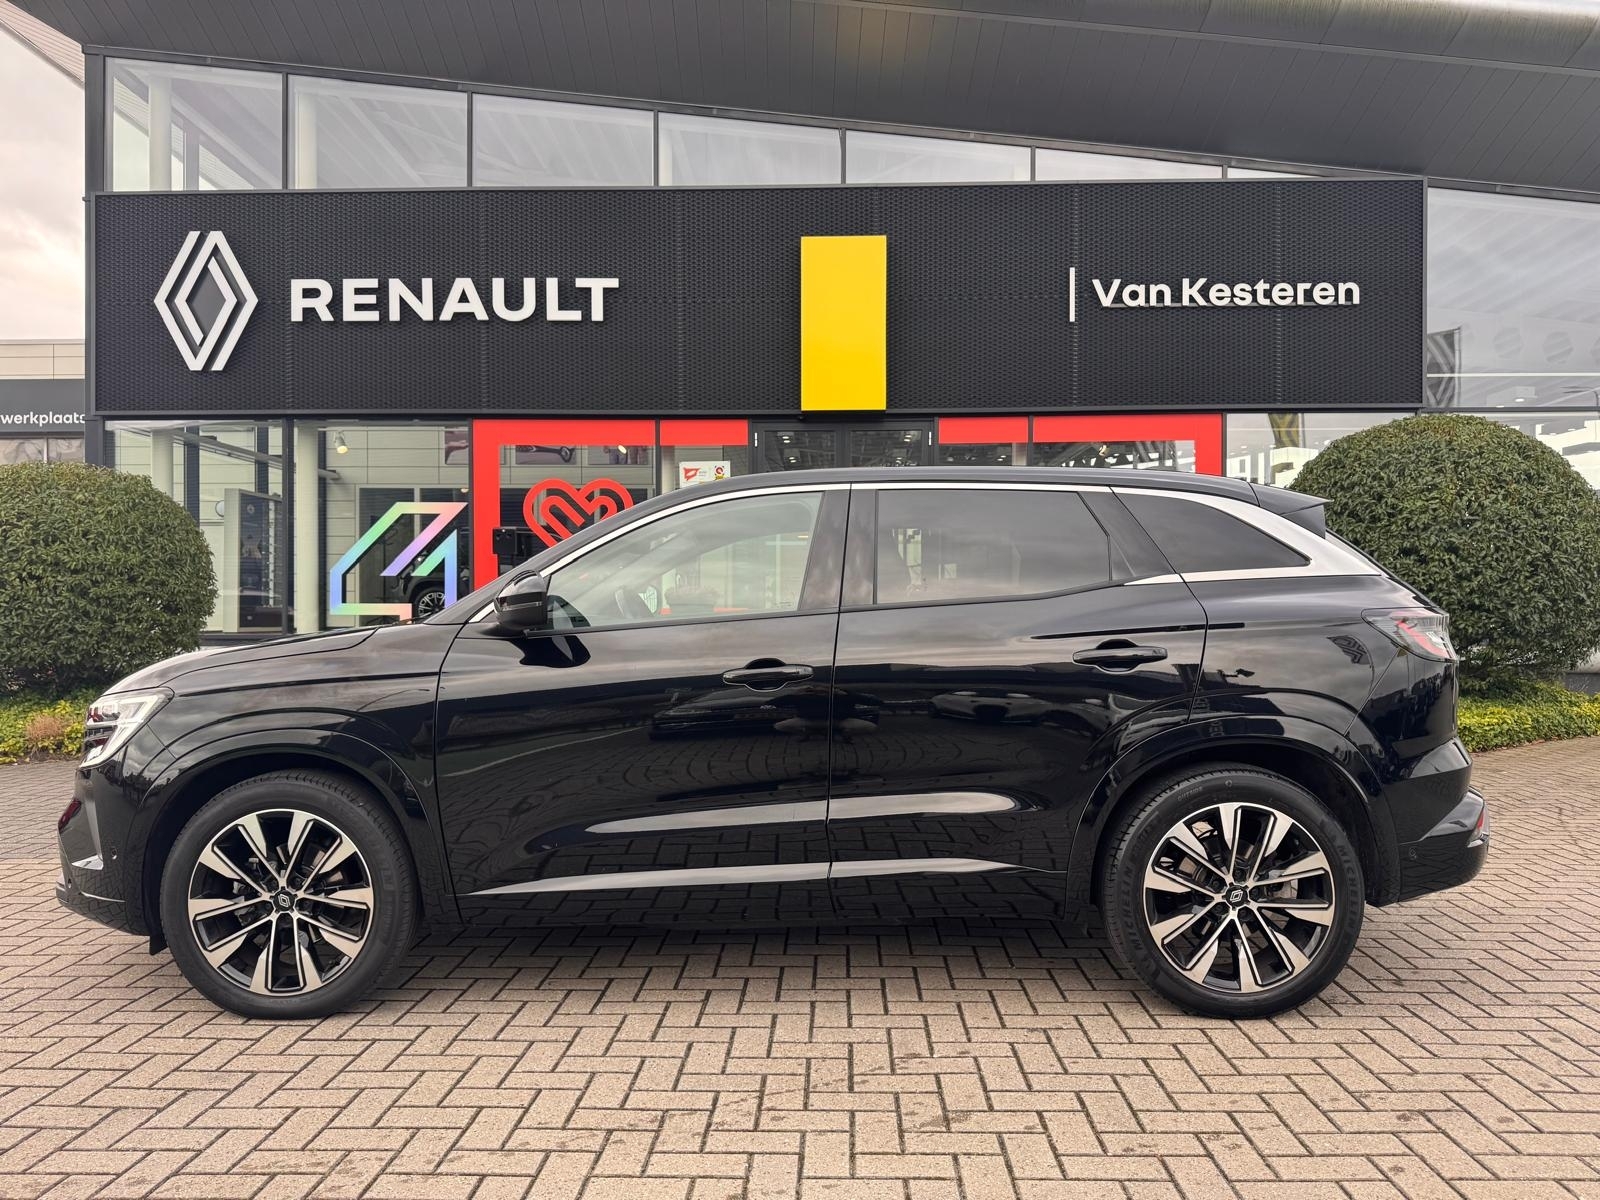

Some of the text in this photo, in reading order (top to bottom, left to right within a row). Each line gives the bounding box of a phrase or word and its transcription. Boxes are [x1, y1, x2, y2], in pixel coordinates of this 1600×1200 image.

[290, 277, 620, 322] RENAULT
[1092, 278, 1361, 307] Van Kesteren
[1120, 864, 1144, 951] MICHELIN
